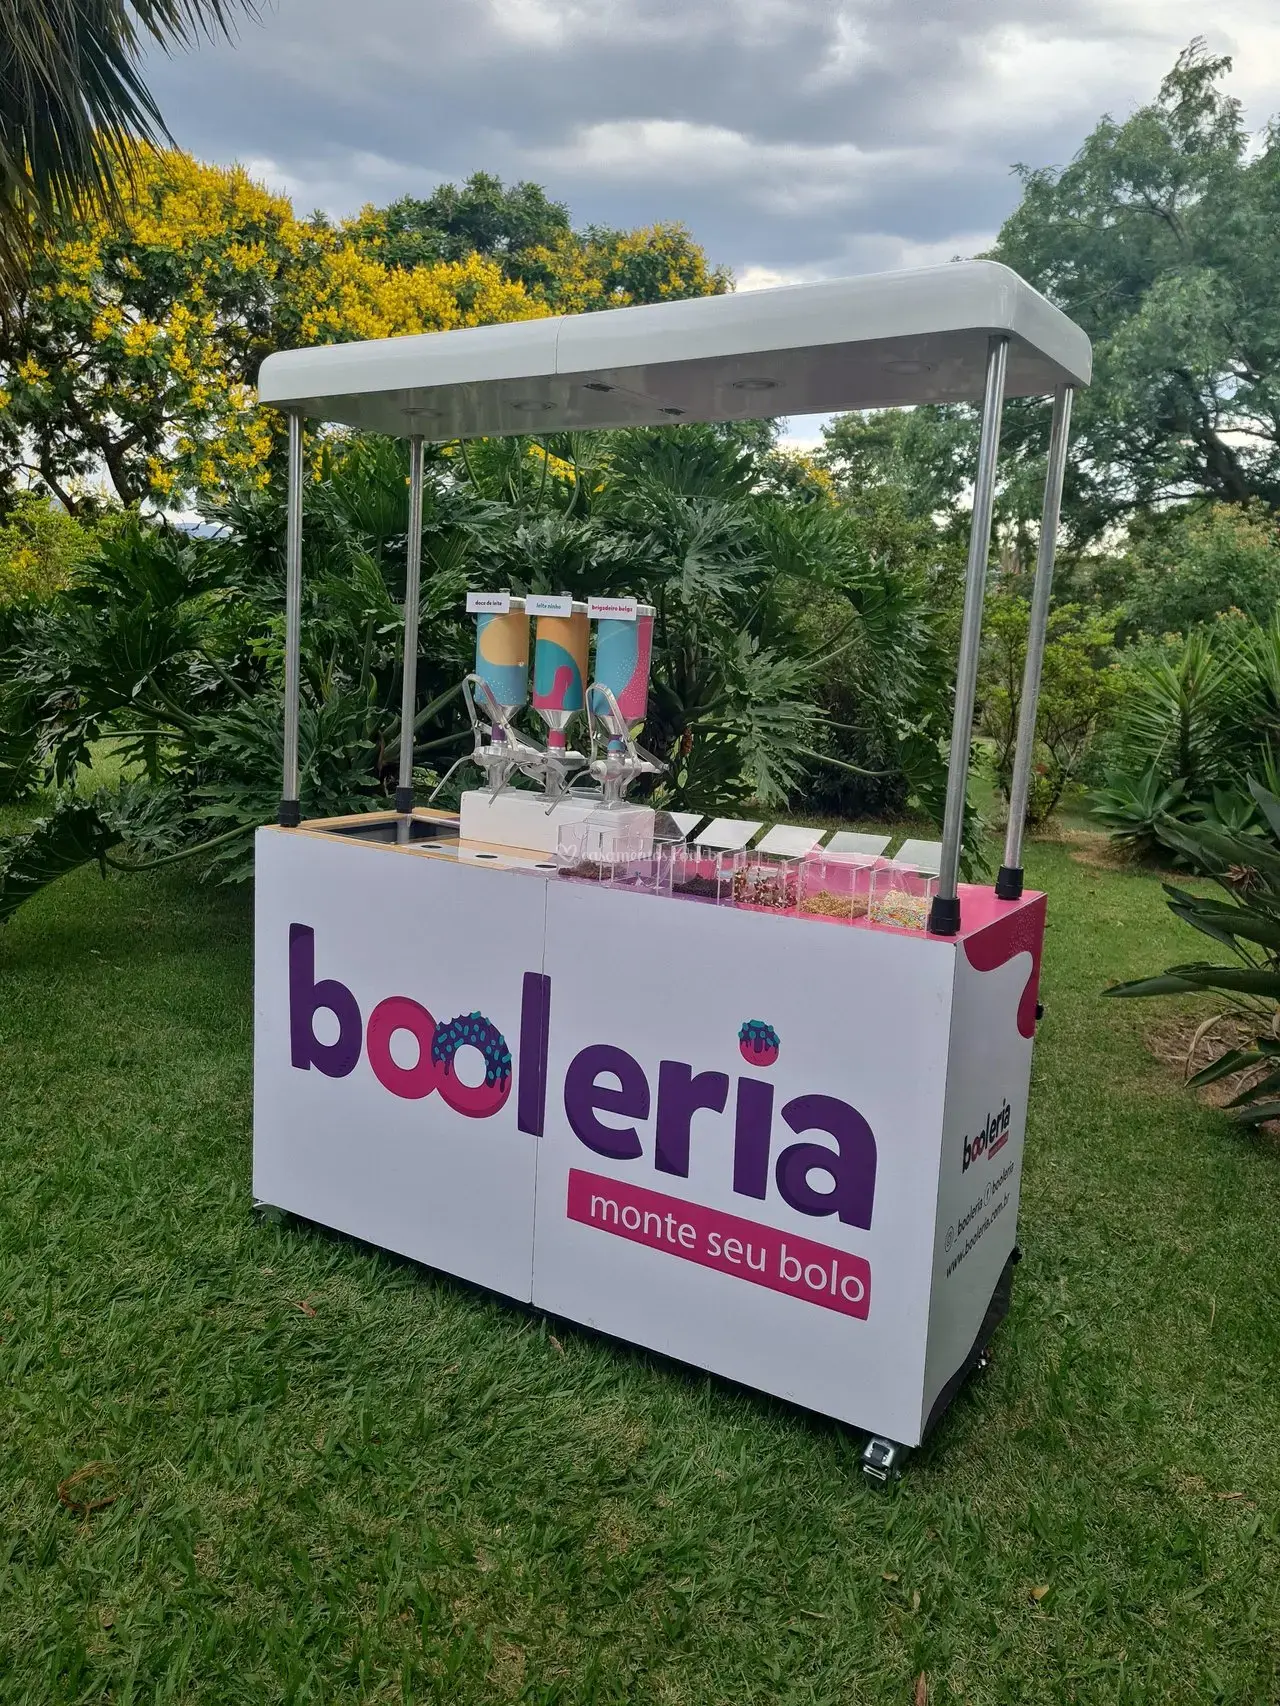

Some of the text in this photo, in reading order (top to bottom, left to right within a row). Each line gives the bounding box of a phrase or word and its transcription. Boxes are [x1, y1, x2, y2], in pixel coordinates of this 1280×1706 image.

[547, 602, 562, 610] ninho
[591, 604, 618, 612] brigadeiro
[288, 922, 878, 1231] booleria
[961, 1097, 1011, 1175] booleria
[991, 1160, 1015, 1196] booleria
[590, 1190, 866, 1304] monte seu bolo
[946, 1192, 1011, 1279] www.booleria.com.br
